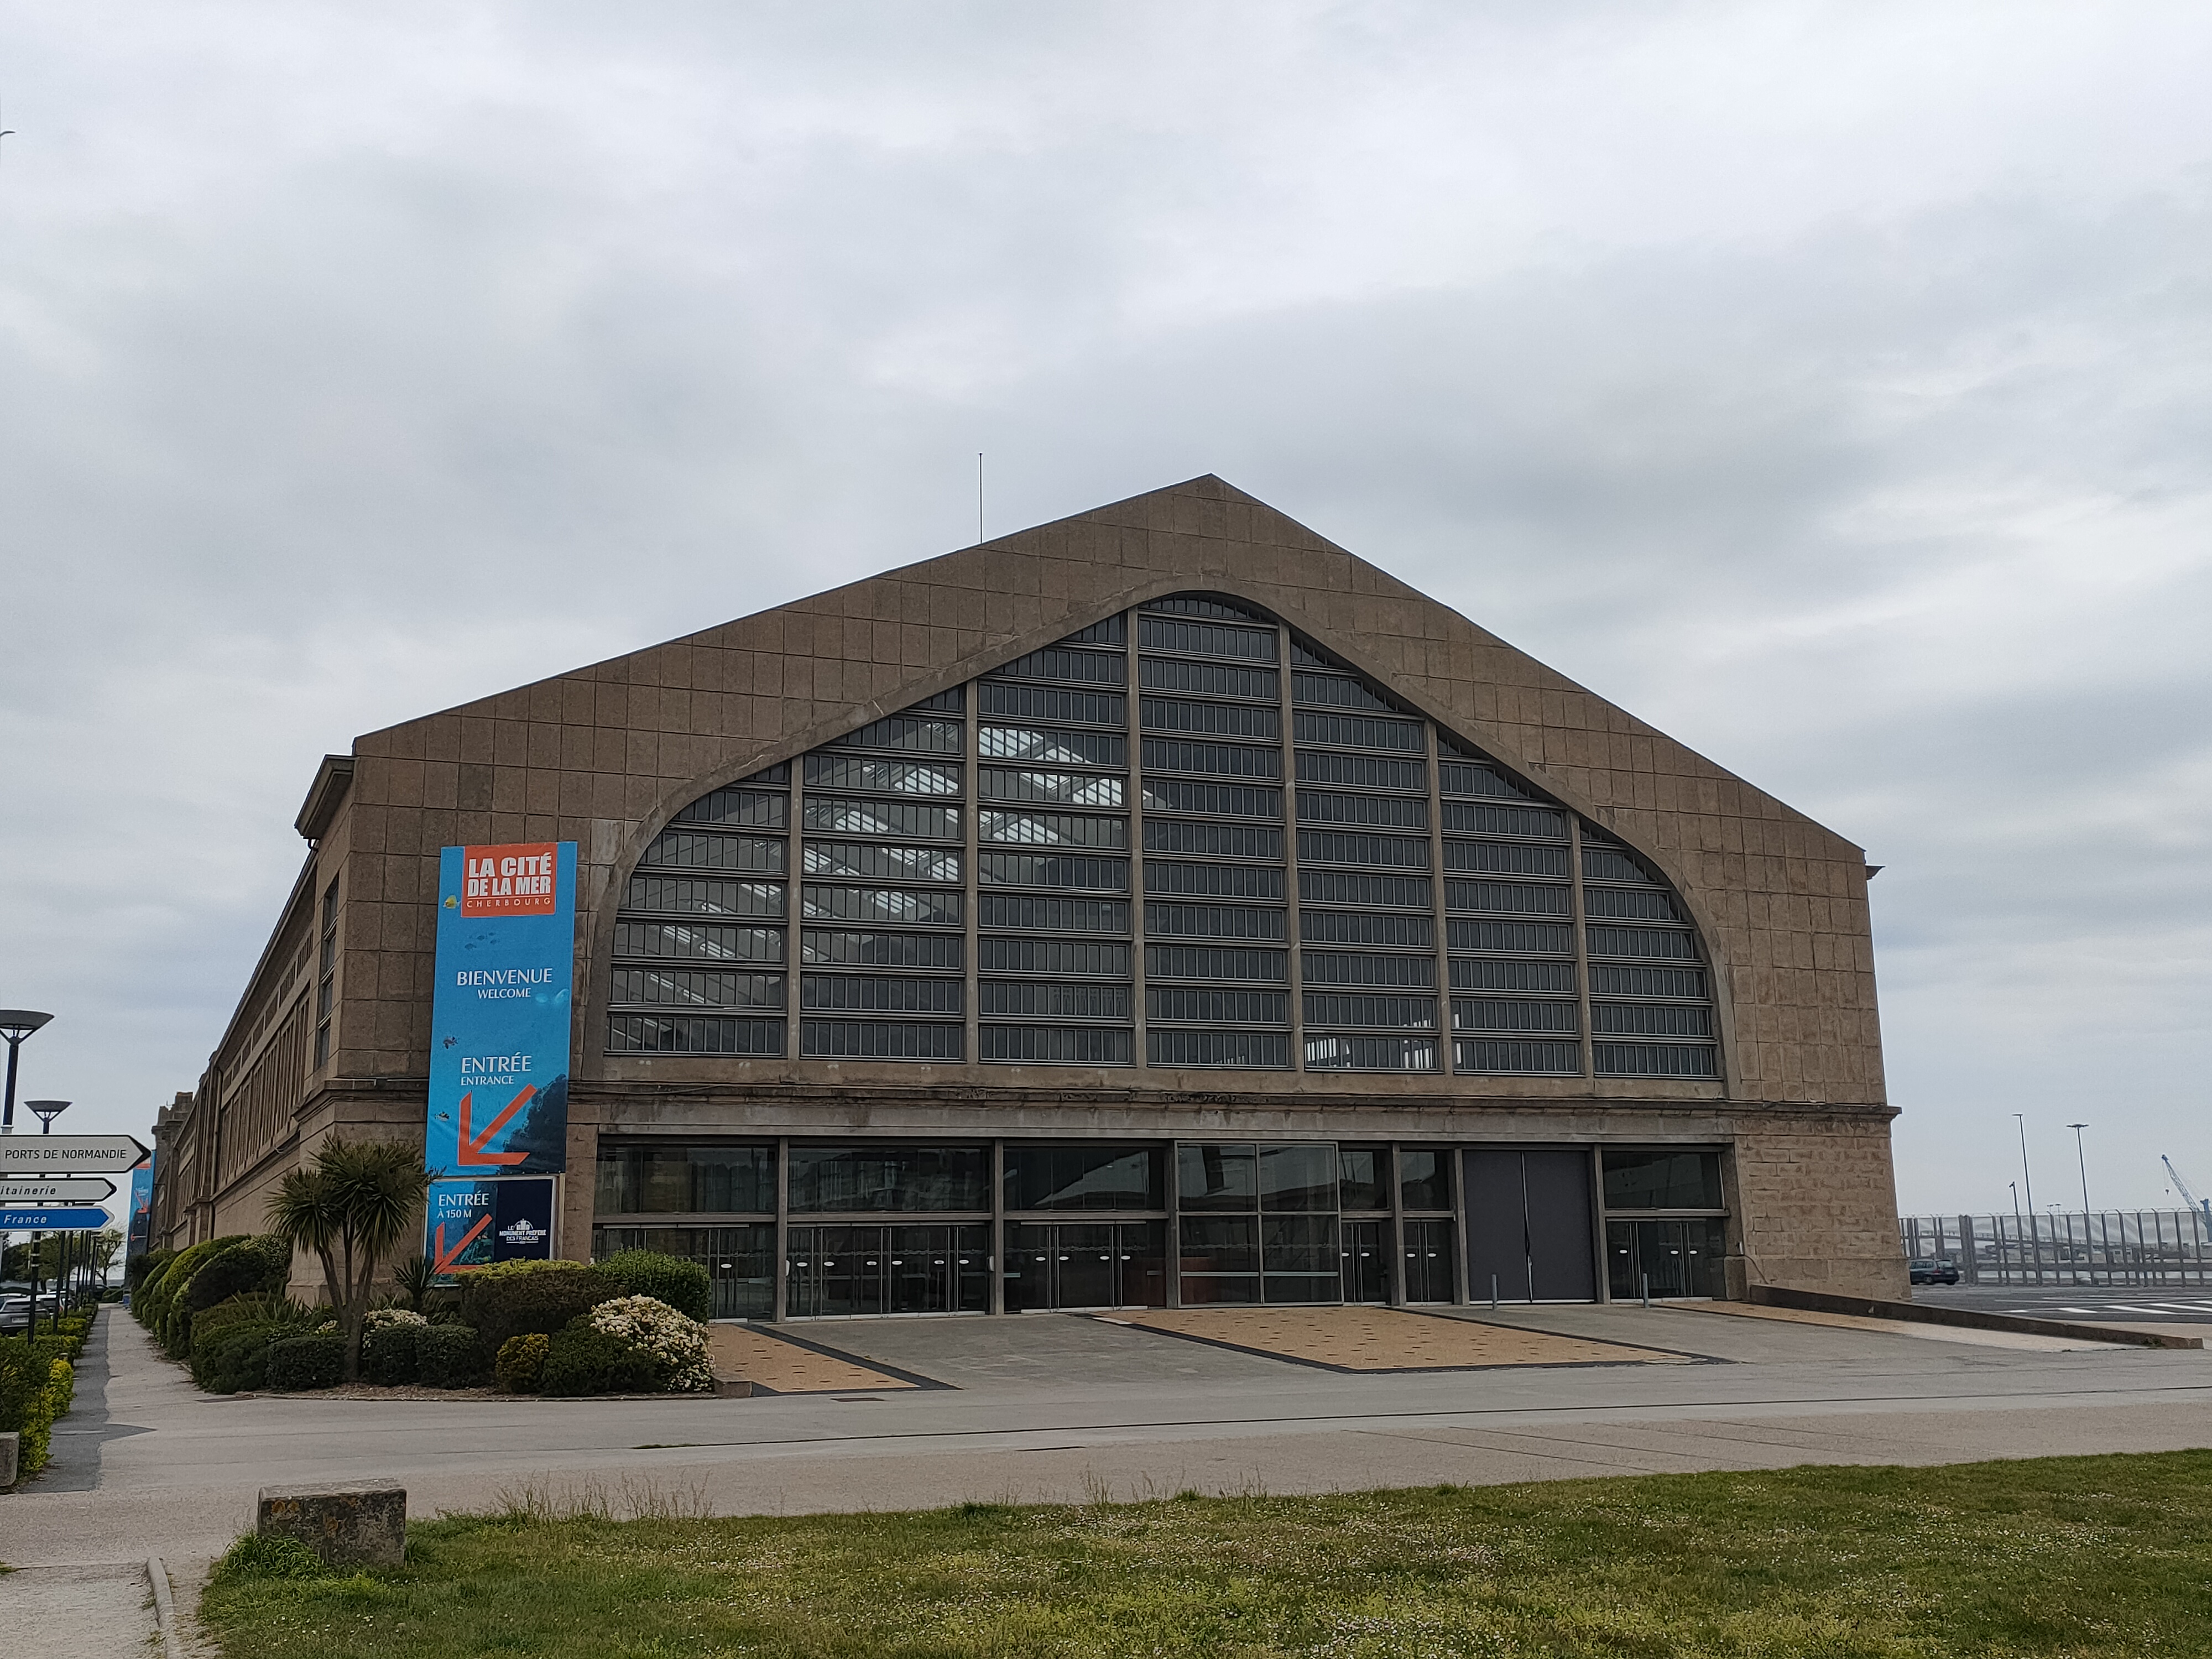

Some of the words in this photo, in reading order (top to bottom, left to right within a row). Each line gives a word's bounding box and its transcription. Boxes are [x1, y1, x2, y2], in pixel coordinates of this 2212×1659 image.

[469, 858, 495, 878] LA
[500, 852, 552, 877] CITÉ
[467, 878, 488, 897] DE
[492, 877, 512, 896] LA
[515, 875, 551, 894] MER
[467, 898, 551, 908] CHERBOURG
[457, 968, 553, 986] BIENVENUE
[477, 988, 531, 999] WELCOME
[462, 1051, 532, 1073] ENTRÉE
[461, 1075, 515, 1086] ENTRANCE
[5, 1149, 40, 1159] PORTS
[43, 1149, 59, 1159] DE
[61, 1149, 127, 1159] NORMANDIE
[439, 1190, 489, 1206] ENTRÉE
[437, 1208, 444, 1218] À
[446, 1209, 462, 1218] 150
[463, 1209, 472, 1218] M
[4, 1214, 47, 1224] France
